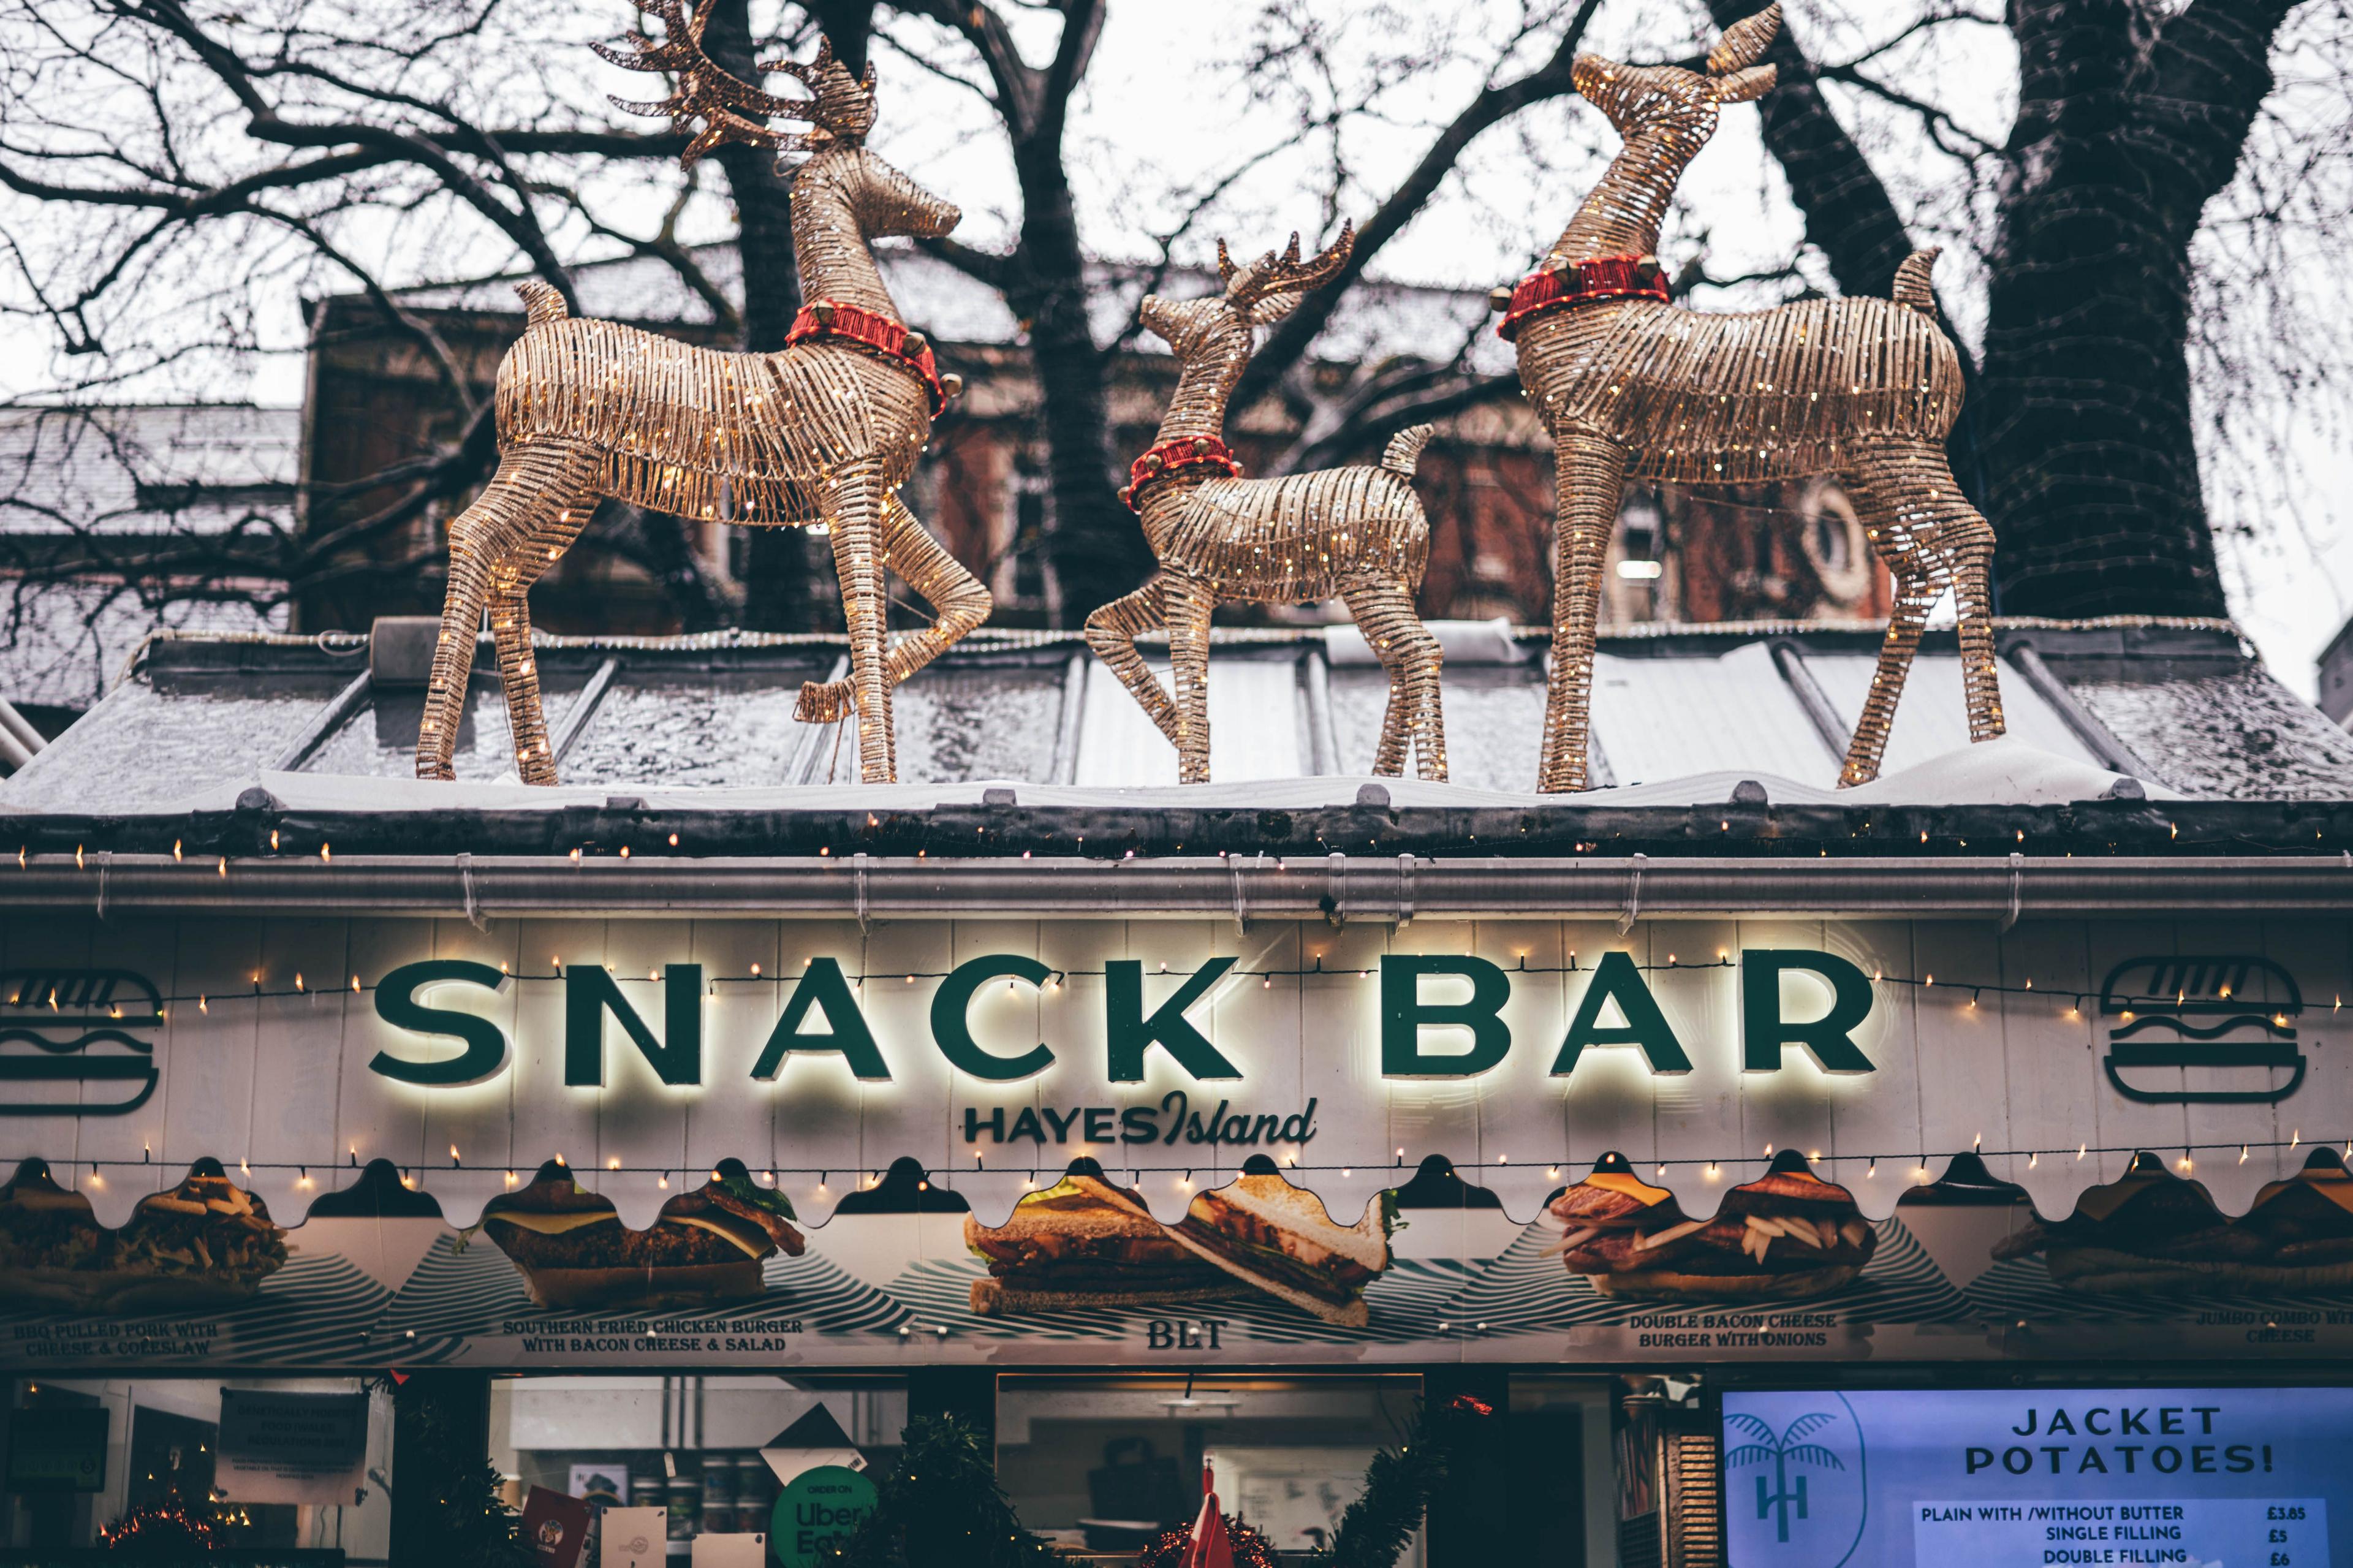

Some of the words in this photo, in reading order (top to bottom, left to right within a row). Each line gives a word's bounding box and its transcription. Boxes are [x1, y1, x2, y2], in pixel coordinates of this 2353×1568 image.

[369, 953, 1244, 1087] SNACK
[1381, 949, 1876, 1078] BAR
[964, 1107, 1158, 1143] HAYES
[1162, 1090, 1317, 1145] Island
[1630, 1315, 1698, 1328] DOUBLE
[1703, 1315, 1765, 1328] BACON
[1768, 1314, 1837, 1328] CHEESE
[2196, 1311, 2256, 1325] JUMBO
[2260, 1311, 2321, 1324] COMBO
[14, 1324, 51, 1340] BBQ
[56, 1323, 120, 1338] PULLED
[126, 1323, 170, 1338] PORK
[175, 1322, 219, 1338] WITH
[503, 1320, 593, 1335] SOUTHERN
[598, 1320, 648, 1334] FRIED
[653, 1320, 727, 1333] CHICKEN
[732, 1320, 803, 1333] BURGER
[1146, 1320, 1229, 1350] BLT
[2246, 1329, 2315, 1343] CHEESE
[523, 1336, 565, 1352] WITH
[570, 1338, 629, 1352] BACON
[634, 1338, 702, 1351] CHEESE
[707, 1338, 719, 1351] &
[724, 1338, 786, 1351] SALAD
[1639, 1333, 1711, 1347] BURGER
[1716, 1331, 1759, 1346] WITH
[1762, 1332, 1827, 1346] ONIONS
[26, 1342, 93, 1357] CHEESE
[99, 1342, 112, 1355] &
[118, 1339, 212, 1355] COLESLAW
[2012, 1407, 2221, 1436] JACKET
[1966, 1445, 2273, 1475] POTATOES!
[808, 1485, 836, 1494] ORDER
[838, 1485, 852, 1494] ON
[797, 1502, 862, 1526] Uber
[1922, 1507, 1974, 1522] PLAIN
[1977, 1507, 2022, 1521] WITH
[2028, 1507, 2115, 1521] /WITHOUT
[2121, 1506, 2184, 1520] BUTTER
[2267, 1507, 2306, 1520] £3.85
[2046, 1526, 2109, 1541] SINGLE
[2114, 1526, 2181, 1540] FILLING
[2268, 1529, 2287, 1543] £5
[2044, 1550, 2113, 1564] DOUBLE
[2120, 1549, 2186, 1564] FILLING
[2270, 1553, 2290, 1567] £6
